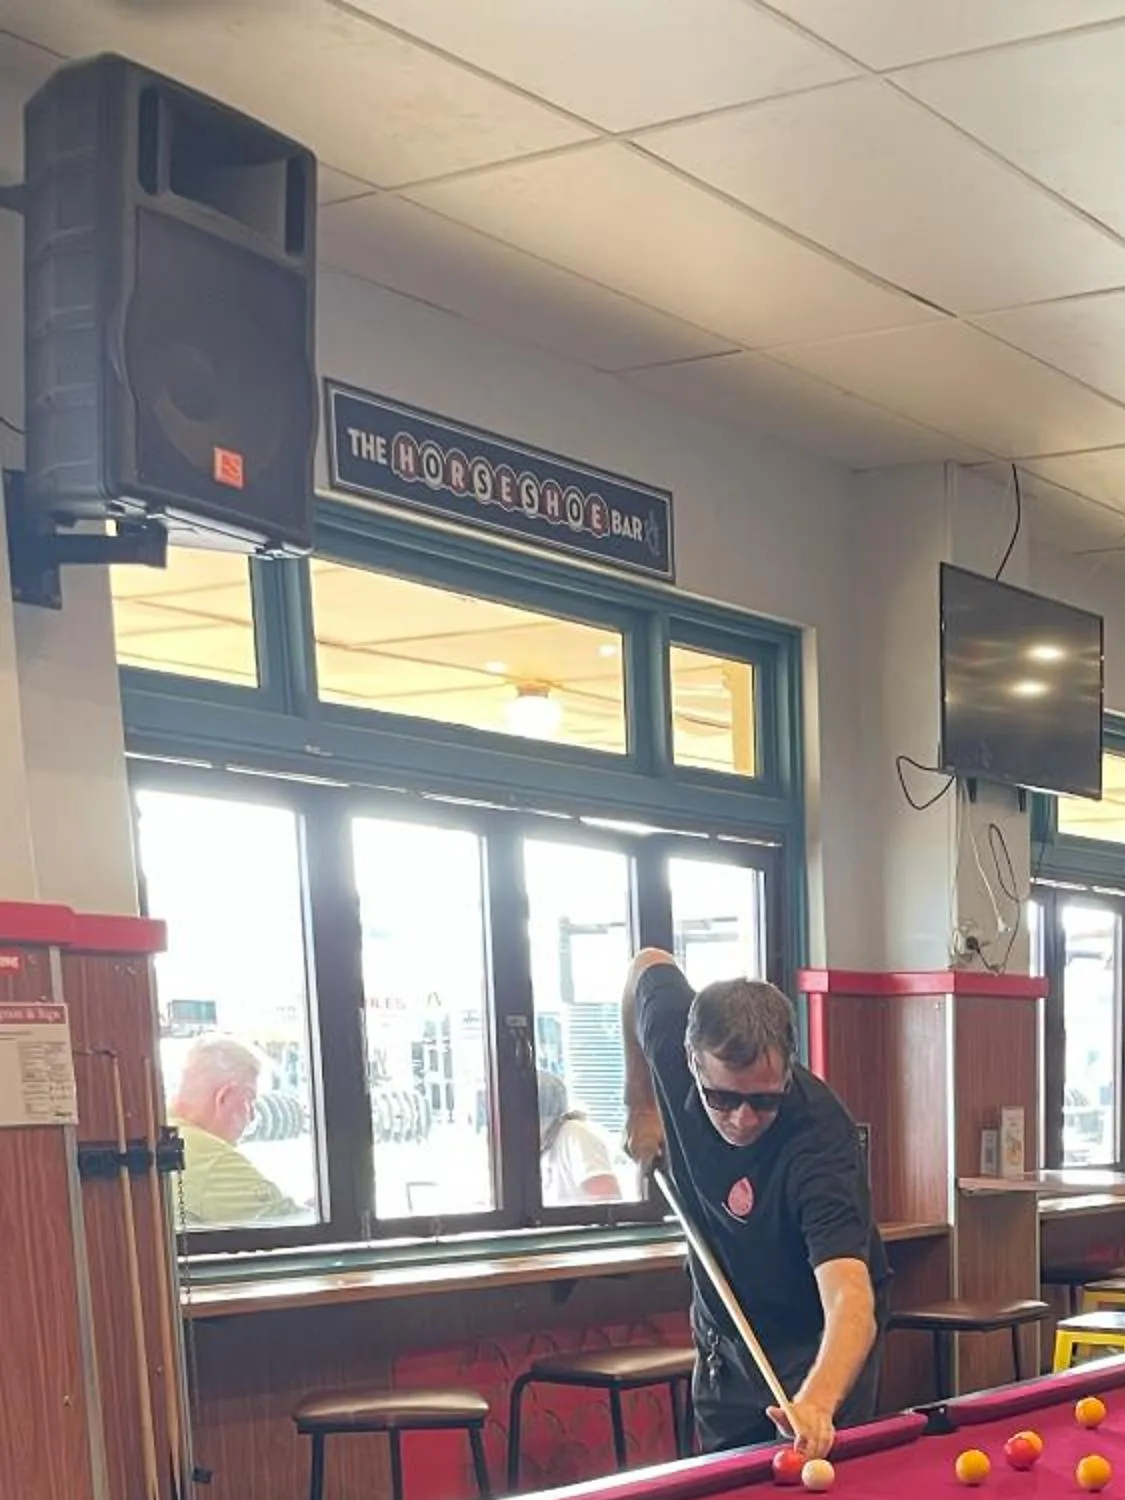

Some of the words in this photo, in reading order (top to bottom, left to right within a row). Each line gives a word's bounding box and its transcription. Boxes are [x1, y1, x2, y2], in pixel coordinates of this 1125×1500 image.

[347, 427, 387, 465] THE
[397, 439, 605, 532] HORSESHOE
[611, 508, 643, 541] BAR
